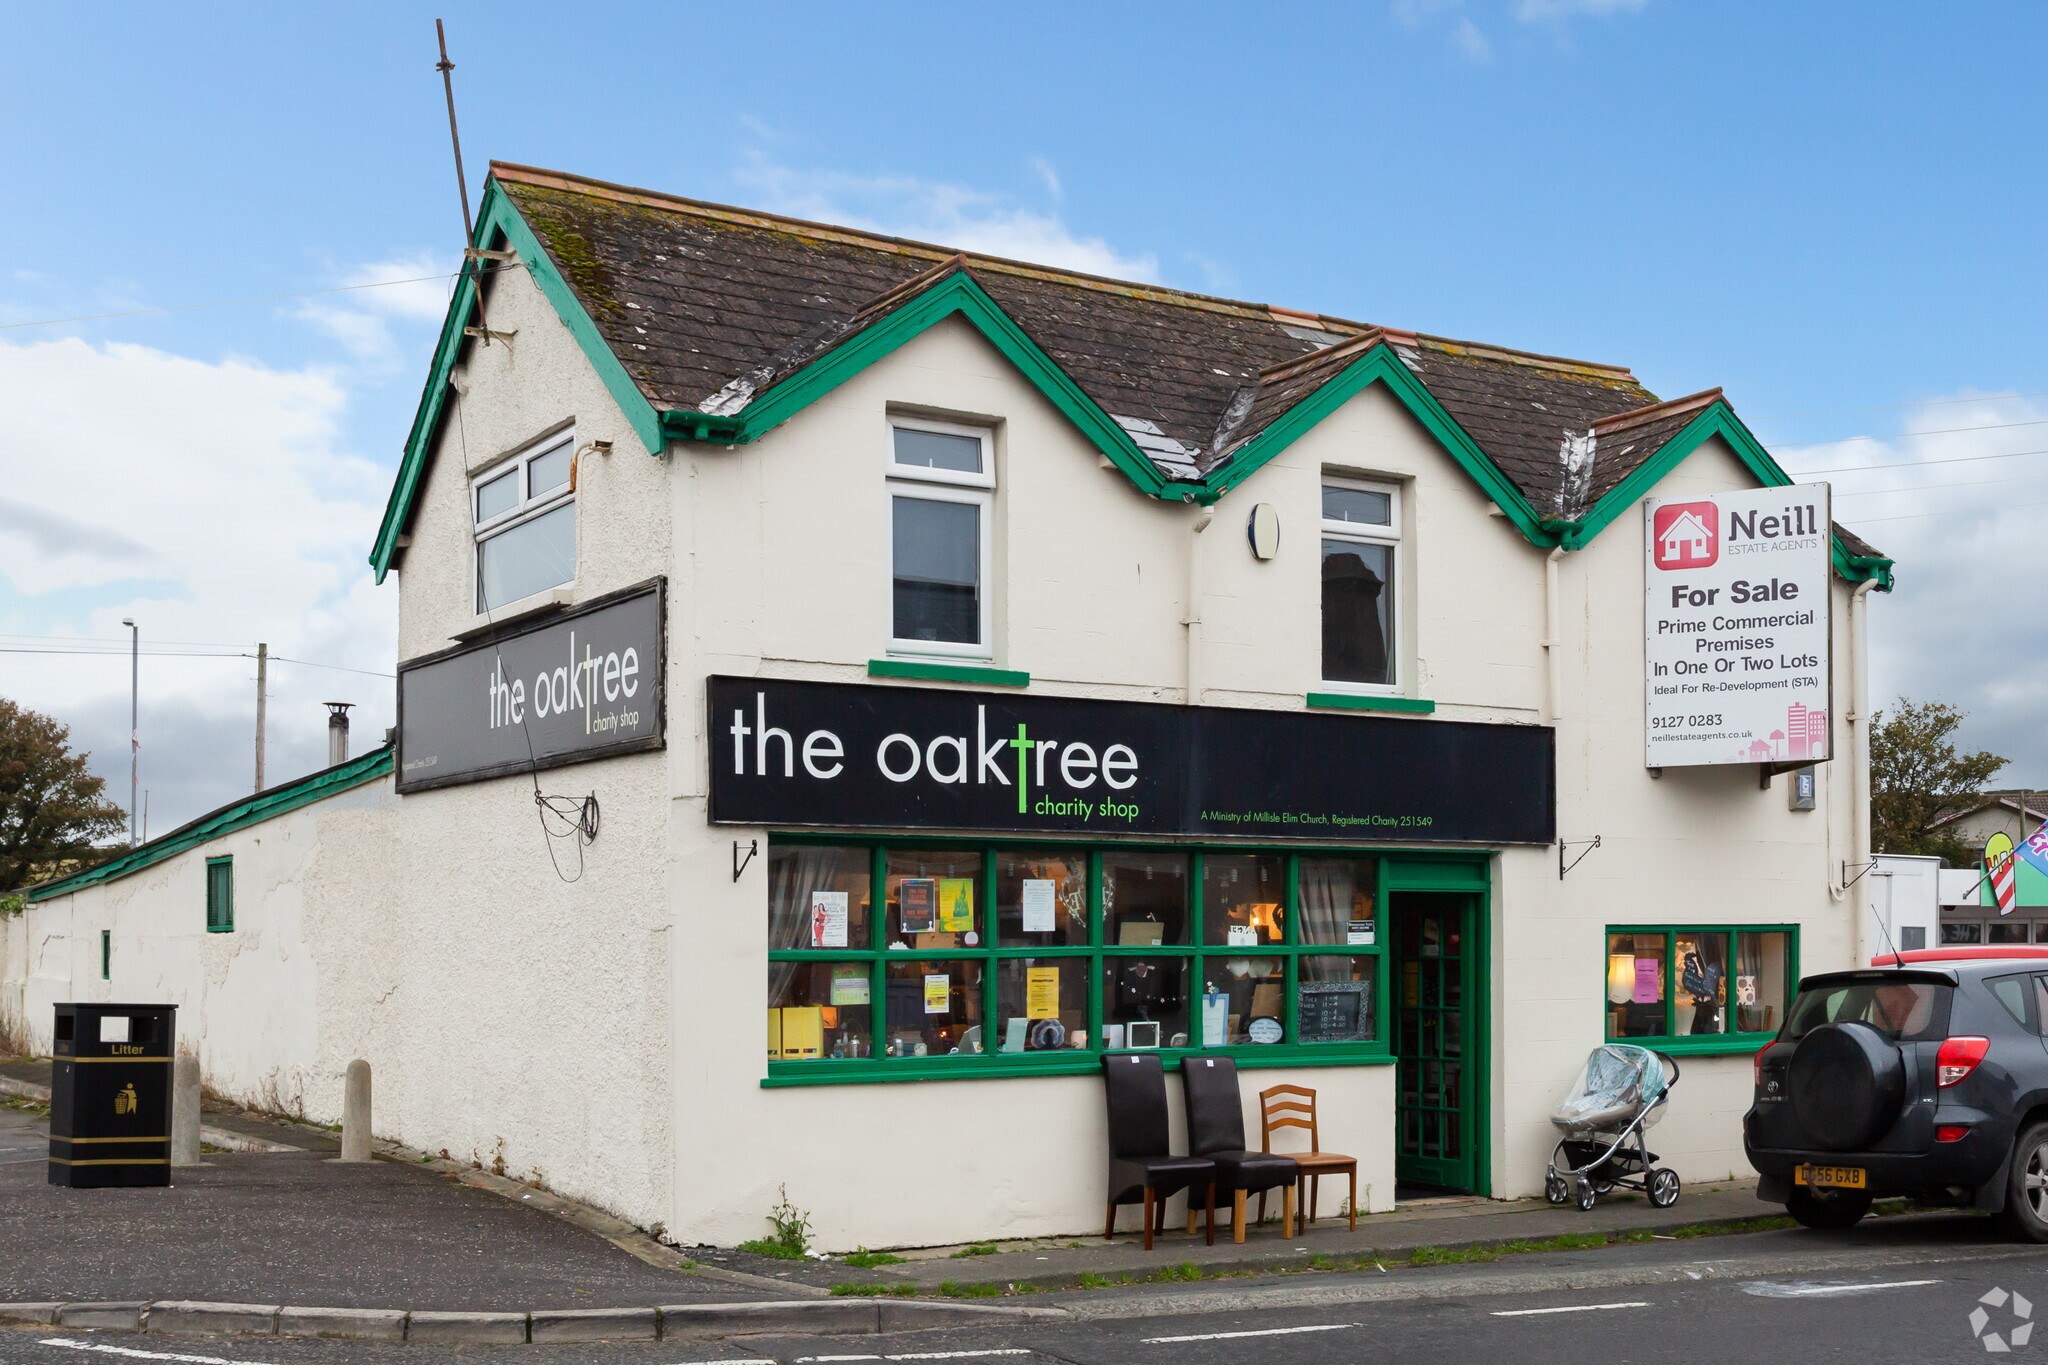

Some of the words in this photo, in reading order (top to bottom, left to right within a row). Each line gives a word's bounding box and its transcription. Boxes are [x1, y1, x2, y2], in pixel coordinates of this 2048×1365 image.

[1728, 505, 1817, 542] Neill
[1728, 542, 1767, 555] ESTATE
[1771, 538, 1817, 552] AGENTS
[1672, 585, 1720, 608] For
[1731, 578, 1799, 603] Sale
[1658, 619, 1706, 634] Prime
[1712, 610, 1814, 631] Commercial
[1696, 636, 1774, 653] Premises
[1654, 662, 1668, 676] In
[1674, 660, 1708, 675] One
[1714, 658, 1735, 672] Or
[1741, 656, 1774, 671] Two
[1780, 653, 1818, 669] Lots
[490, 654, 525, 729] the
[534, 631, 639, 735] oaktree
[1655, 685, 1678, 695] Ideal
[1682, 683, 1698, 693] For
[1702, 678, 1788, 692] Re-Development
[1792, 677, 1818, 689] (STA)
[593, 712, 618, 735] charity
[620, 705, 639, 731] shop
[1652, 716, 1685, 729] 9127
[1688, 714, 1723, 727] 0283
[1652, 730, 1753, 742] neillestateagents.co.uk
[730, 692, 844, 779] the
[877, 704, 1139, 814] oaktree
[1035, 795, 1093, 822] charity
[1099, 797, 1139, 822] shop
[1200, 810, 1208, 820] A
[1210, 811, 1241, 824] Ministry
[1243, 811, 1252, 822] of
[1282, 812, 1298, 823] Elim
[1300, 812, 1330, 826] Church,
[1332, 814, 1370, 827] Registered
[1372, 814, 1399, 829] Charity
[1400, 816, 1433, 827] 251549
[111, 1044, 145, 1055] Litter
[1836, 1168, 1860, 1184] GXB
